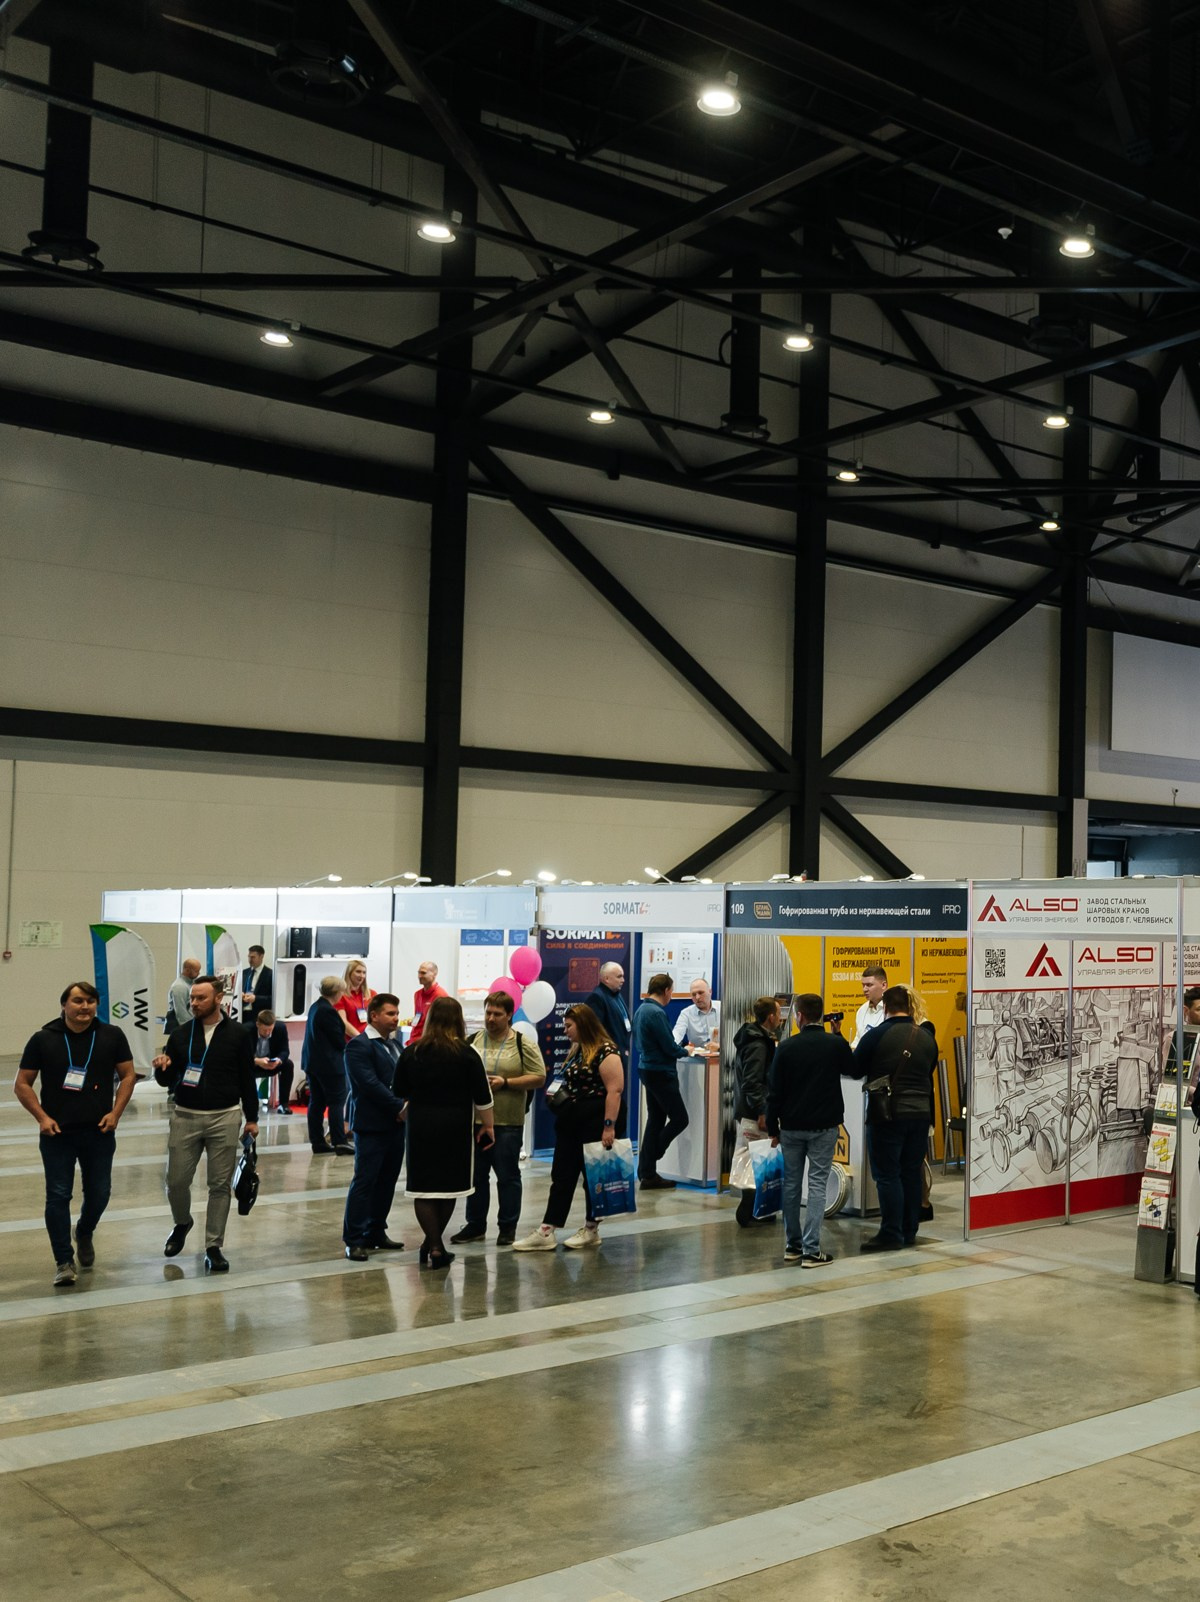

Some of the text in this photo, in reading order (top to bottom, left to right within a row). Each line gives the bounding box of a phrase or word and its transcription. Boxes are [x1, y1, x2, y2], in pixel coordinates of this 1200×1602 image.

[1009, 898, 1079, 912] ALSO
[1086, 898, 1109, 906] ЗАВОД
[603, 902, 640, 915] SORMAT
[730, 903, 745, 914] 109
[778, 905, 829, 916] Гофрированная
[829, 907, 849, 916] труба
[858, 905, 909, 916] нержавеющей
[909, 907, 931, 916] стали
[942, 904, 961, 914] iPRO
[1092, 916, 1125, 924] ОТВОДОВ
[1125, 916, 1132, 924] Г.
[1132, 916, 1174, 924] ЧЕЛЯБИНСК
[545, 929, 607, 941] SORMAT
[573, 942, 625, 950] соединении
[832, 946, 896, 956] ГОФРИРОВАННАЯ ТРУБА
[921, 947, 967, 957] ИЗ НЕРЖАВЕЮЩЕЙ
[1077, 947, 1155, 963] ALSO
[832, 959, 901, 968] ИЗ НЕРЖАВЕЮЩЕЙ СТАЛИ
[1117, 968, 1155, 976] ЭНЕРГИЕЙ
